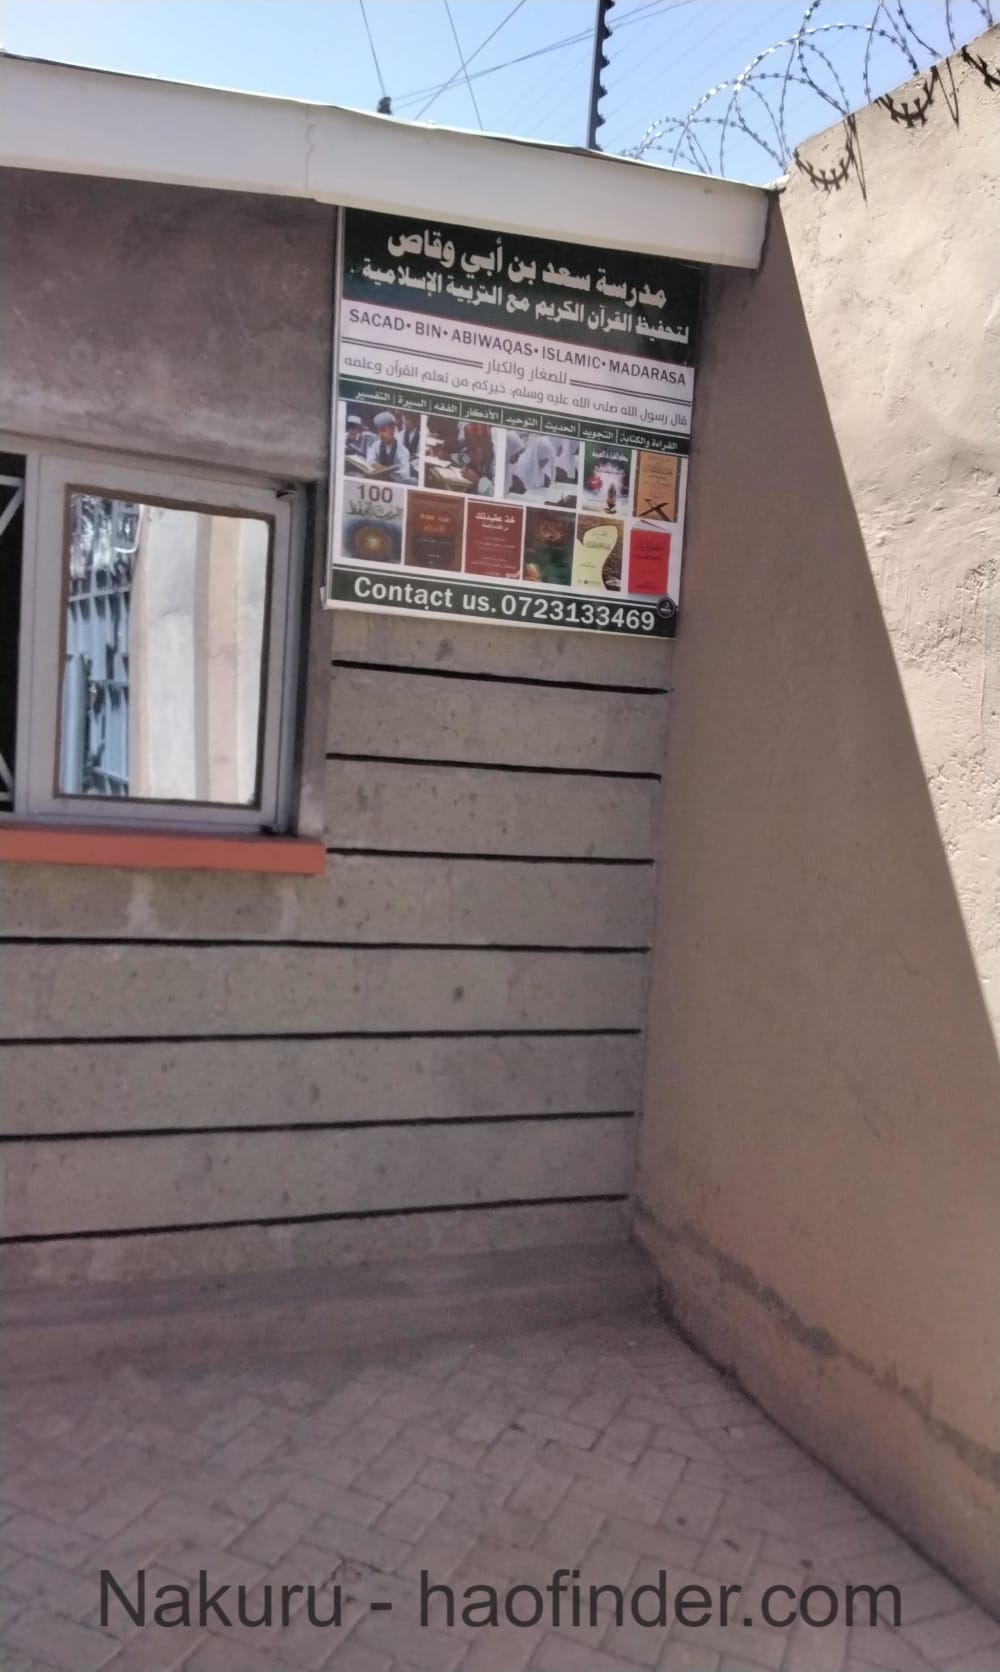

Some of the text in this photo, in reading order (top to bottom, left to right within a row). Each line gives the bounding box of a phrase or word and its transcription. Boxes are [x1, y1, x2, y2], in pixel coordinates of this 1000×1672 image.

[387, 229, 668, 308] مدرسة سعد بن أبي وقاص
[361, 257, 690, 345] لتحفيظ القرآن الكريم مع التربية الإسلامية
[344, 356, 383, 375] وعلمه
[385, 360, 419, 379] القرآن
[484, 358, 568, 385] للصغار والكبار
[609, 359, 687, 387] MADARASA
[451, 374, 469, 389] من
[546, 392, 569, 406] عليه
[571, 396, 590, 409] الله
[592, 401, 618, 414] صلى
[619, 404, 638, 417] الله
[640, 408, 669, 426] رسول
[357, 484, 393, 504] 100
[353, 575, 454, 608] Contact
